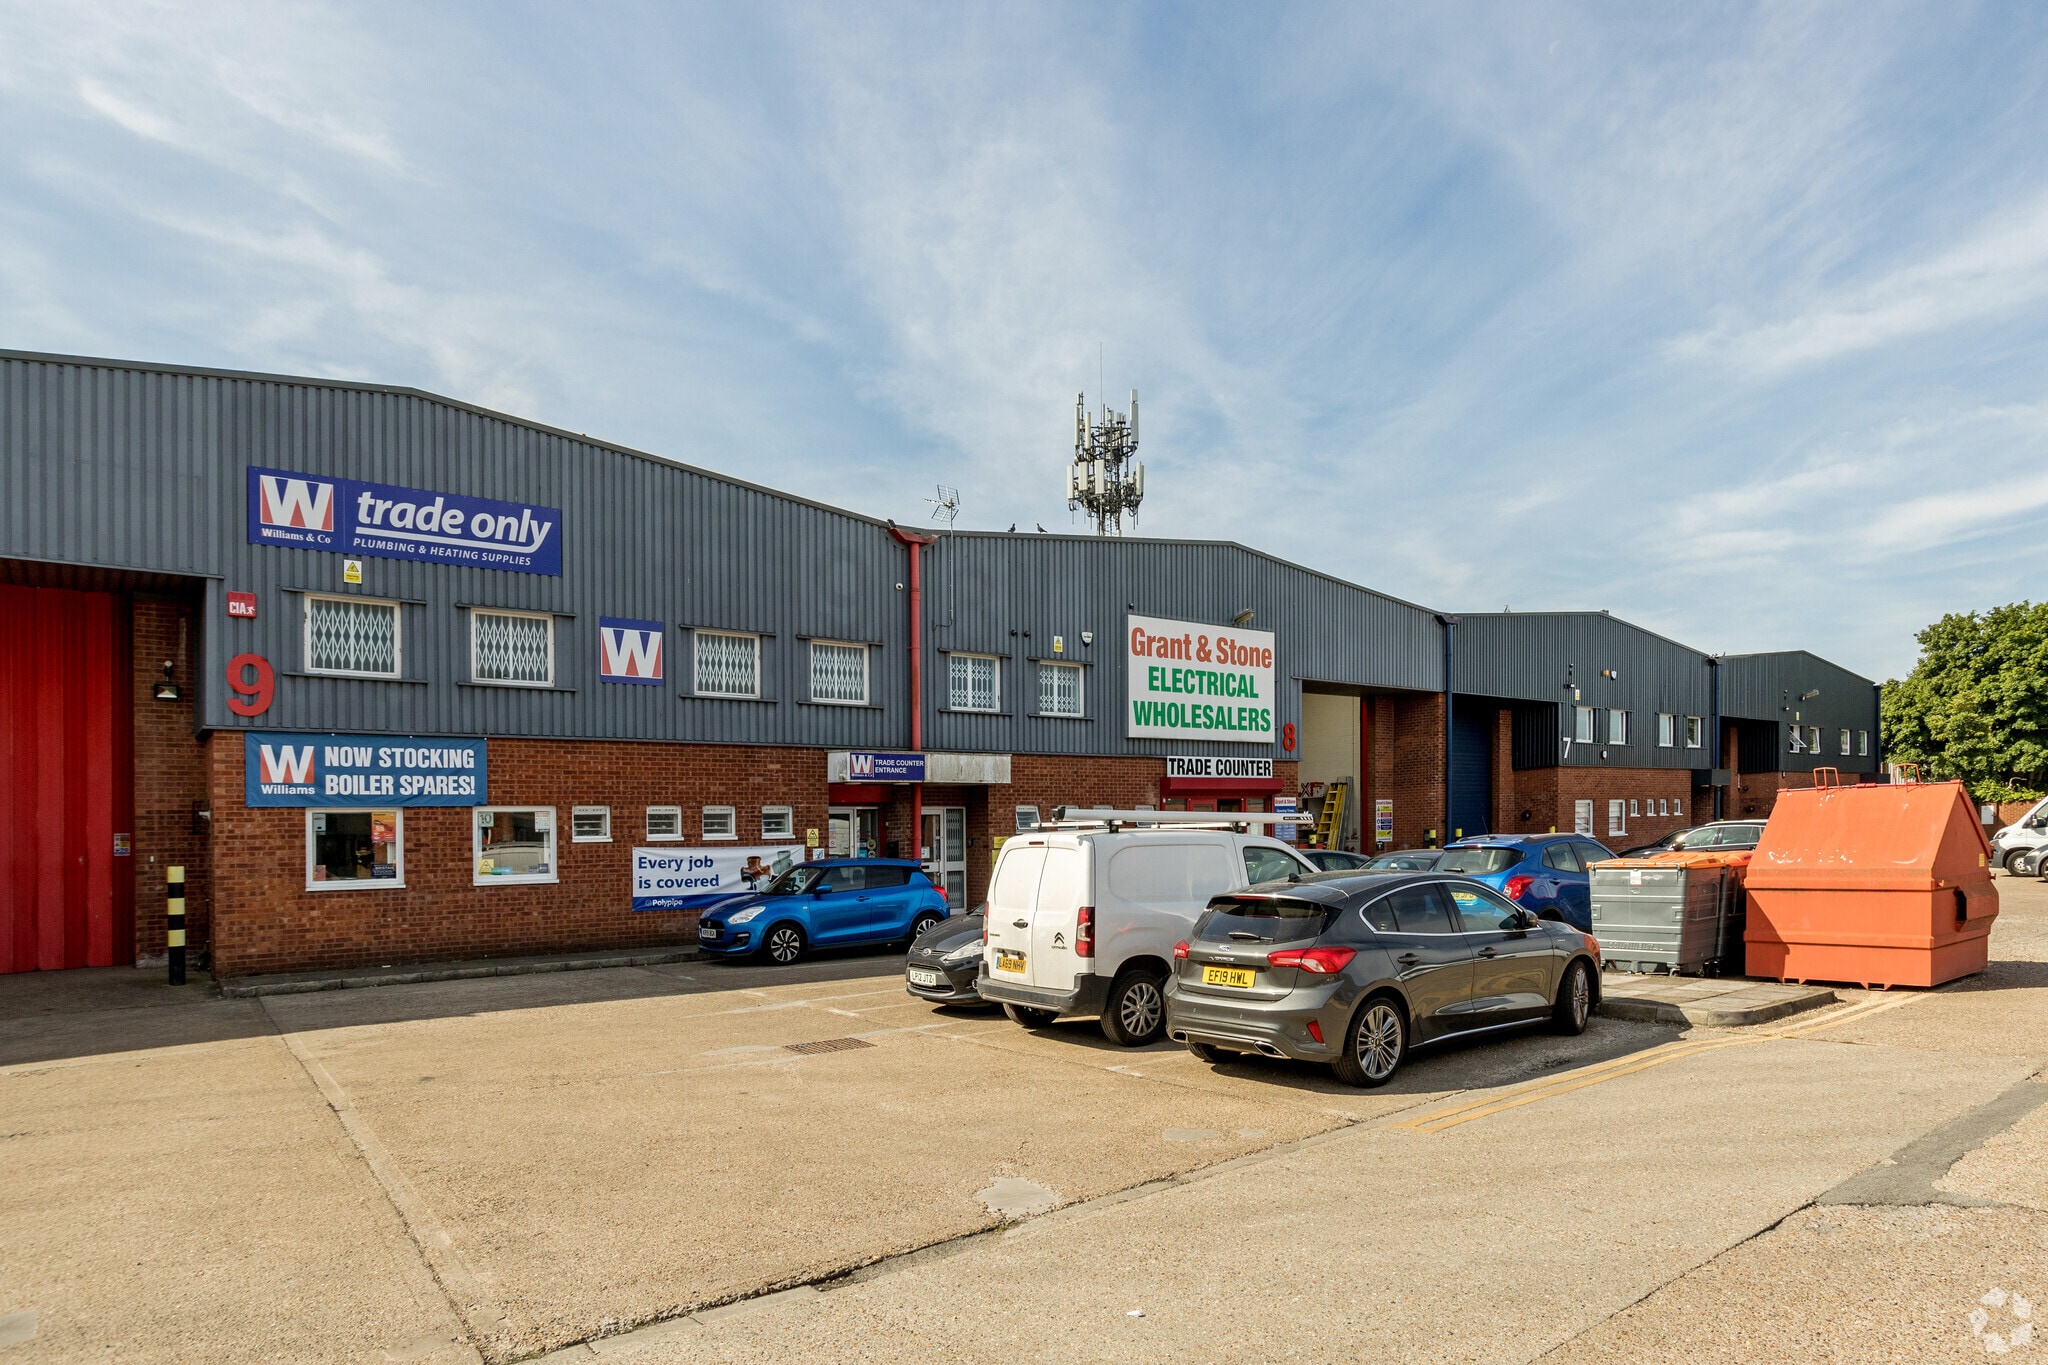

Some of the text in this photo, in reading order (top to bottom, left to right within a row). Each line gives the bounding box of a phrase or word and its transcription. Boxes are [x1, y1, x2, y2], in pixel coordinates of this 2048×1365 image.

[260, 475, 334, 532] W
[357, 491, 552, 553] trade only
[261, 528, 331, 544] Williams & Co
[353, 537, 531, 566] PLUMBING & HEATING SUPPLIES
[229, 601, 246, 615] CIA
[600, 627, 662, 679] W
[1131, 626, 1272, 669] Grant & Stone
[226, 653, 275, 717] 9
[1148, 665, 1259, 699] ELECTRICAL
[1132, 700, 1271, 732] WHOLESALERS
[1283, 723, 1296, 752] 8
[1563, 737, 1571, 759] 7
[324, 746, 475, 769] NOW STOCKING
[895, 759, 924, 767] COUNTER
[1168, 758, 1272, 777] TRADE COUNTER
[874, 766, 907, 774] ENTRANCE
[260, 784, 316, 795] Williams
[325, 774, 476, 796] BOILER SPARES!
[638, 855, 714, 872] Every job
[638, 874, 719, 889] is covered
[652, 898, 683, 908] Polypipe
[1208, 969, 1248, 985] EF19 HWL
